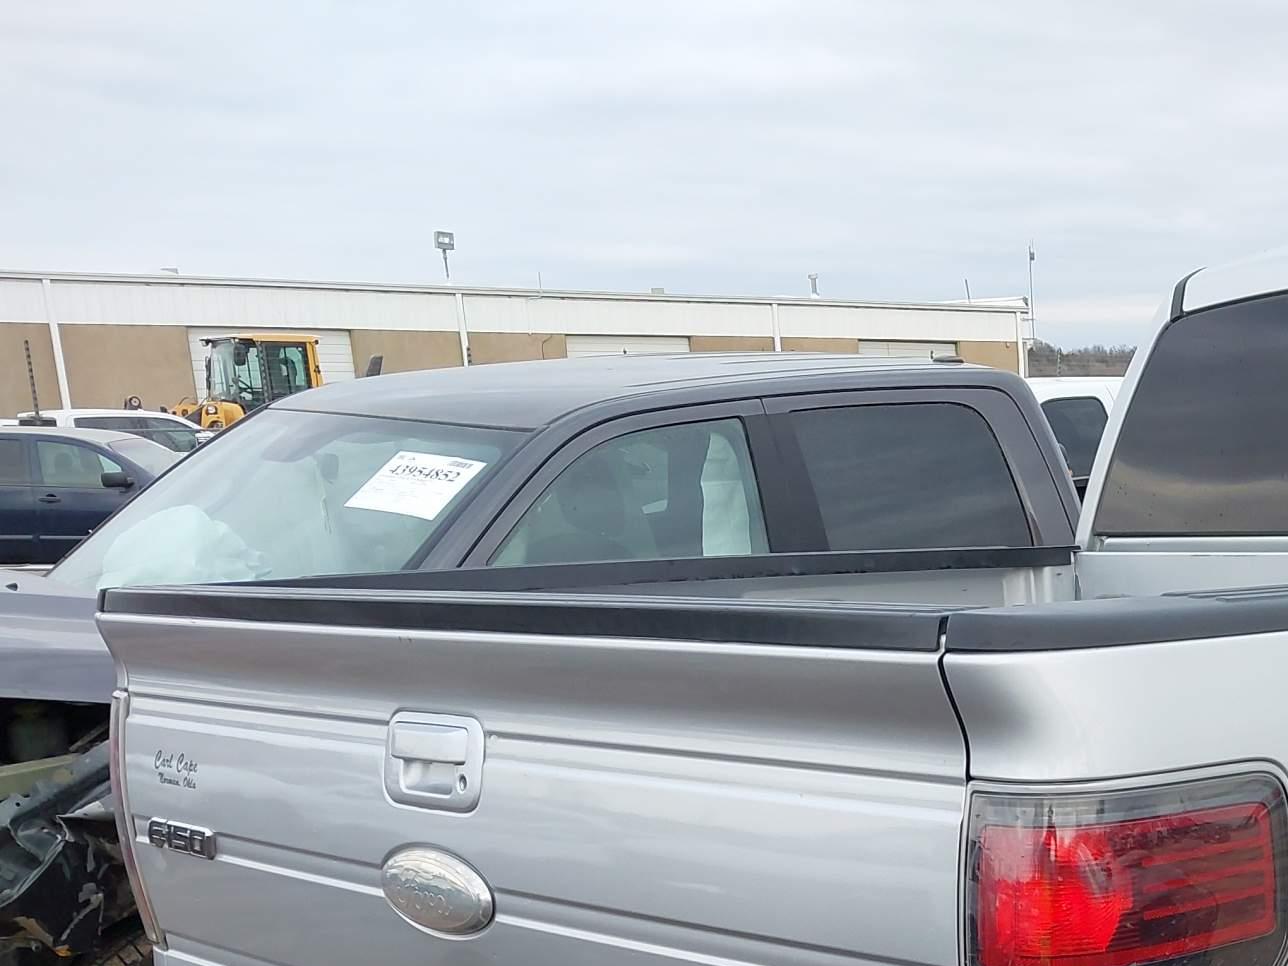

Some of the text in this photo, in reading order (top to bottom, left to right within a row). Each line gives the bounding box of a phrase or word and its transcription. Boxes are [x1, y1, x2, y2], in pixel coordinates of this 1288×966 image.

[389, 463, 461, 482] 43954852
[154, 750, 198, 776] Carl Cape
